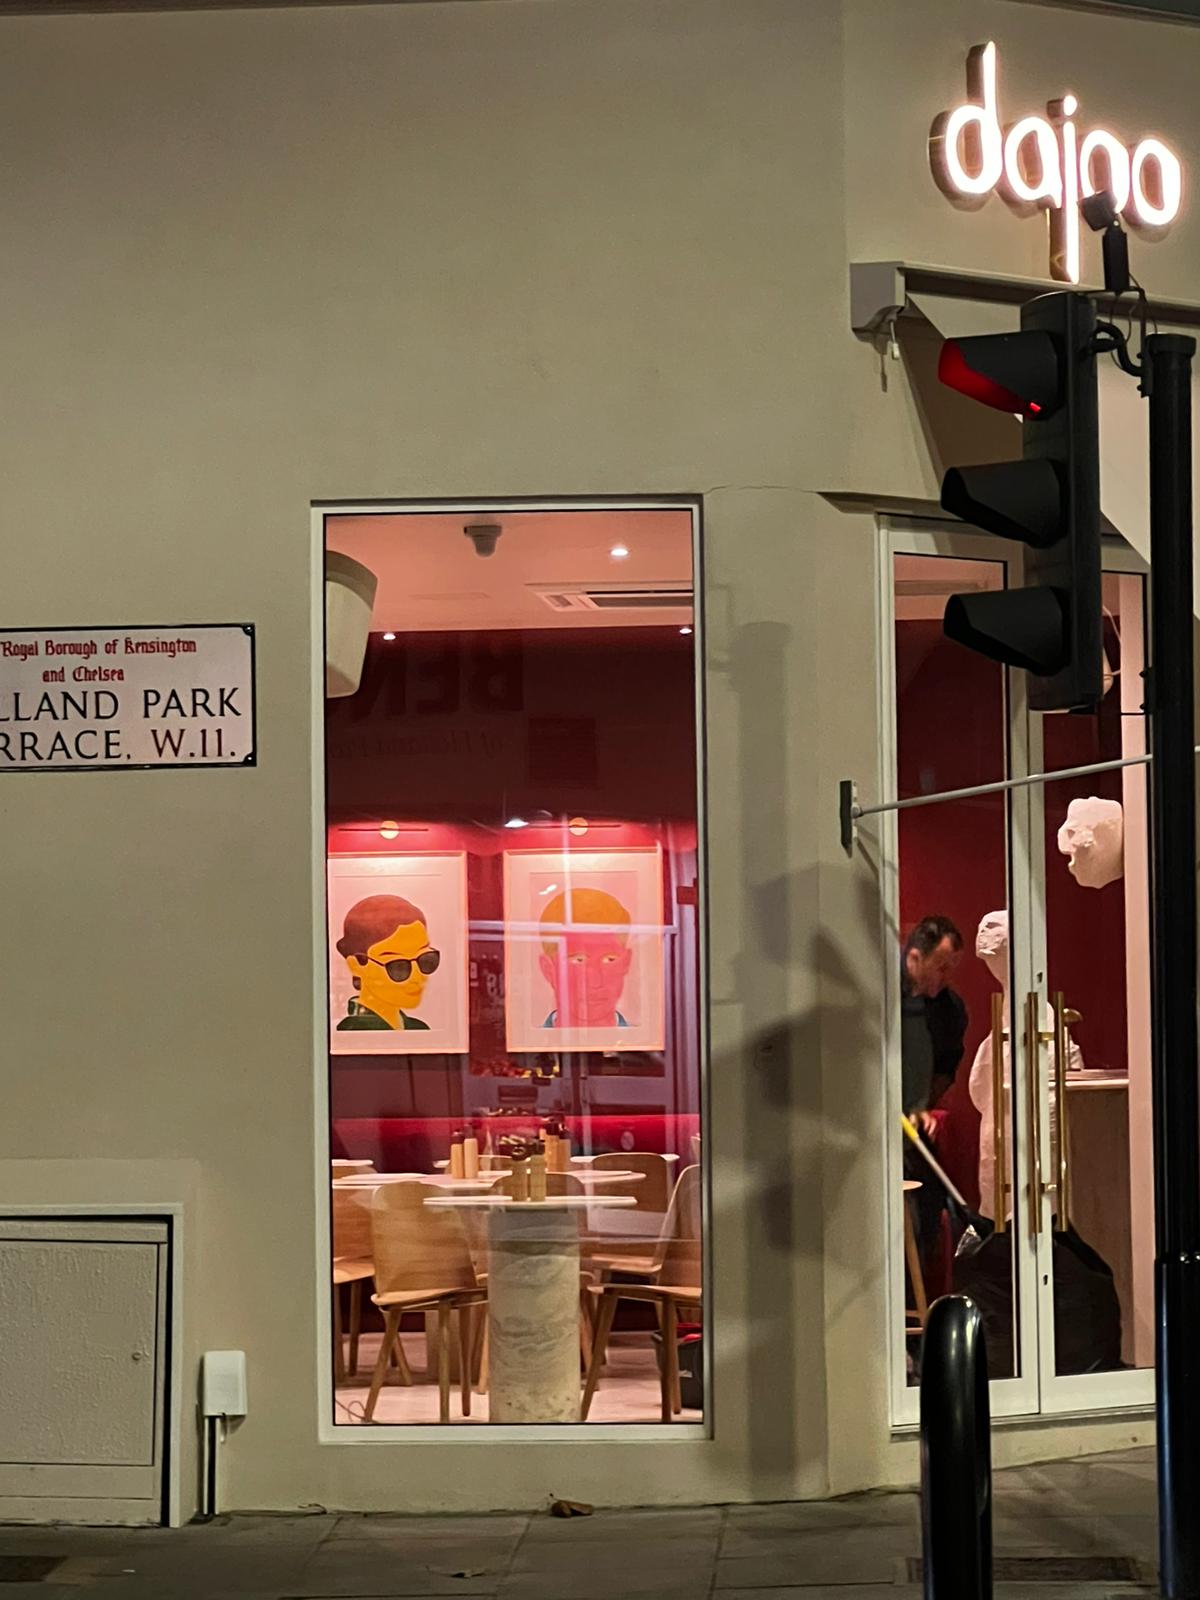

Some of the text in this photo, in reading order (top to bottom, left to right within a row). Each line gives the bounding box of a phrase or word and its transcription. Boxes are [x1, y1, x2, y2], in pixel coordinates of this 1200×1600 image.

[0, 637, 197, 661] Royal Borough of Kensington
[42, 666, 124, 682] and Chelsea
[143, 687, 242, 719] PARK
